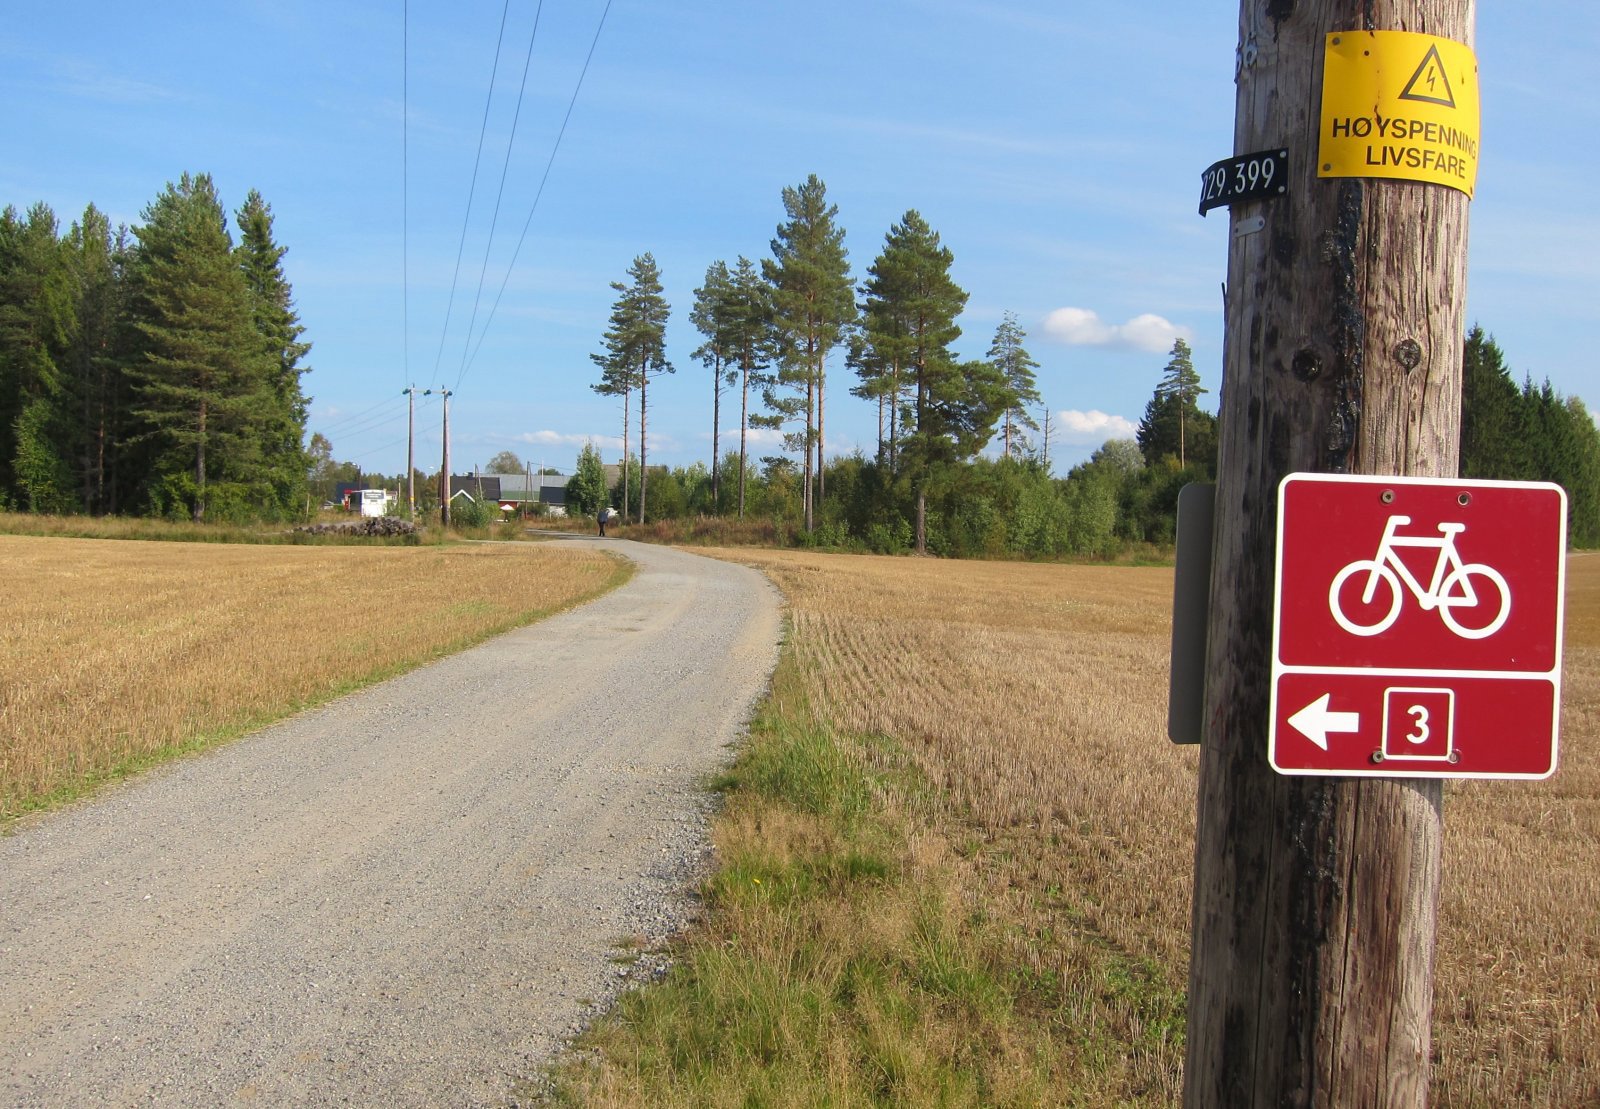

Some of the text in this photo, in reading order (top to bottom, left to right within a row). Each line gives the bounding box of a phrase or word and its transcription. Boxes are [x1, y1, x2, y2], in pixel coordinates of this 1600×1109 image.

[1332, 116, 1476, 159] HØYSPENNING
[1365, 145, 1466, 179] LIVSFARE
[1406, 704, 1430, 744] 3
